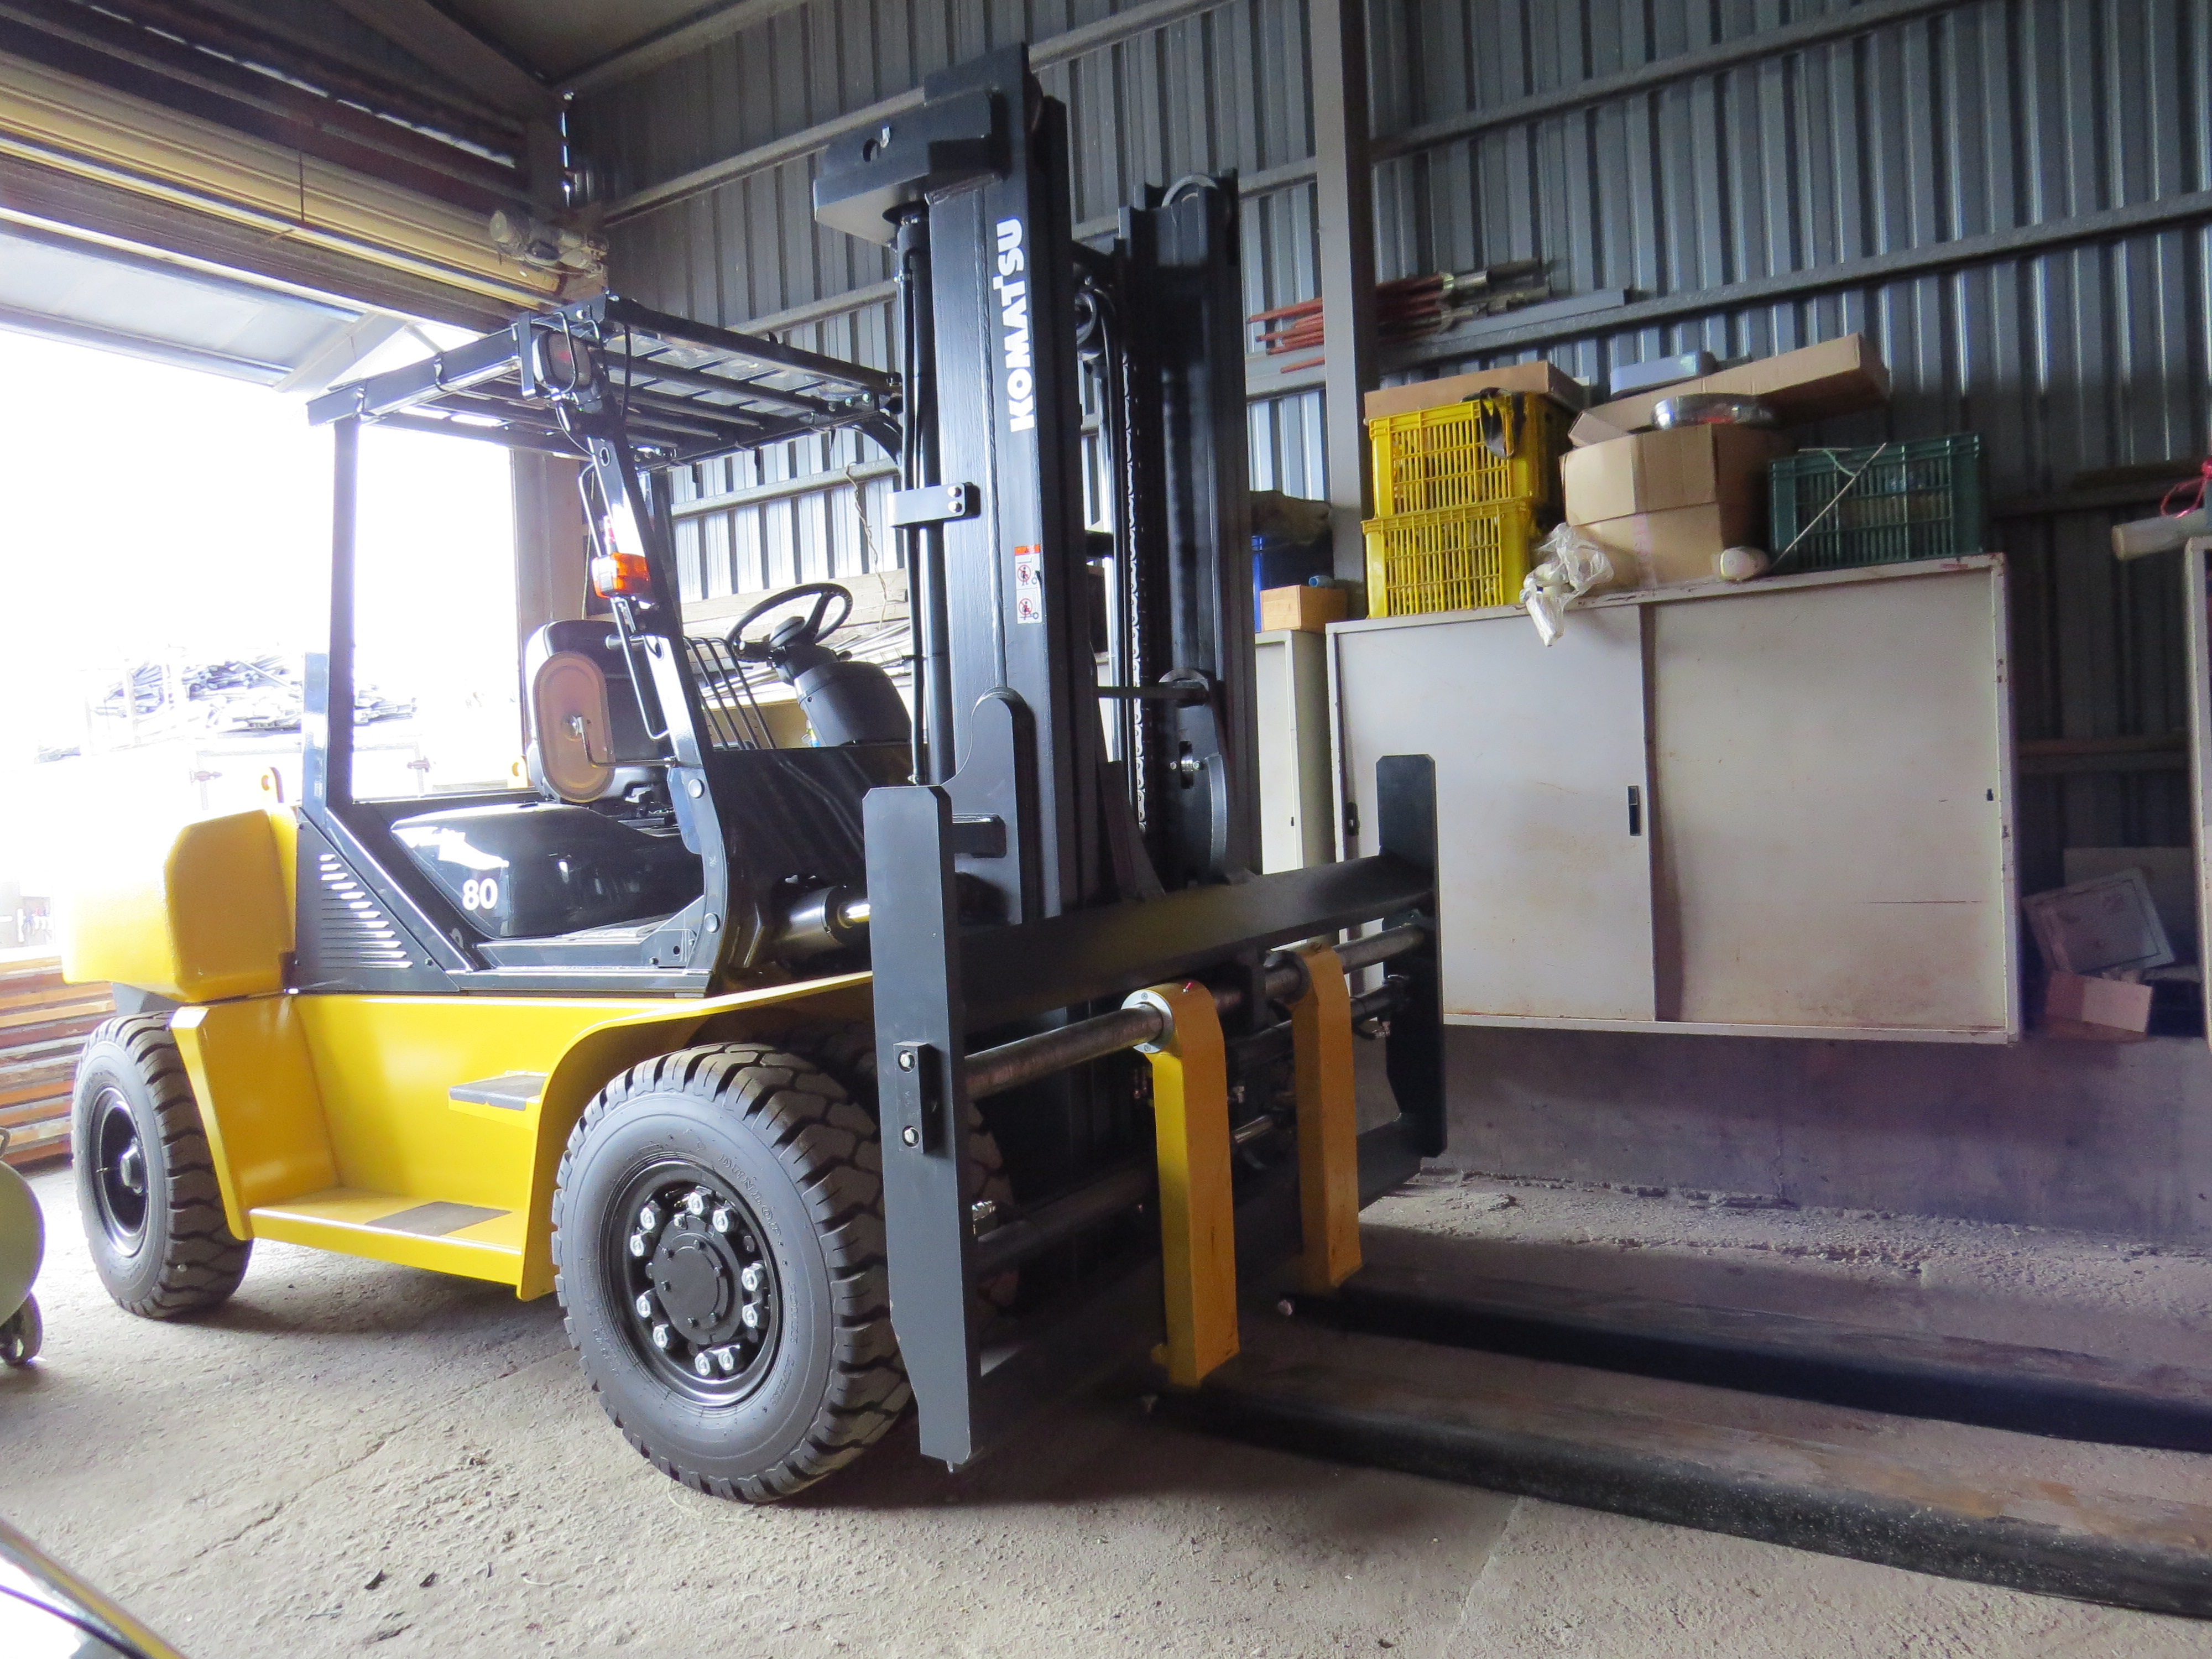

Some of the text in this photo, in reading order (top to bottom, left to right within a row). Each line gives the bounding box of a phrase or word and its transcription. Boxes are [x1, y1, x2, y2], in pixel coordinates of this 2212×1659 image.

[993, 219, 1035, 432] KOMATSU
[462, 878, 498, 911] 80
[718, 1154, 782, 1237] DUNLOP
